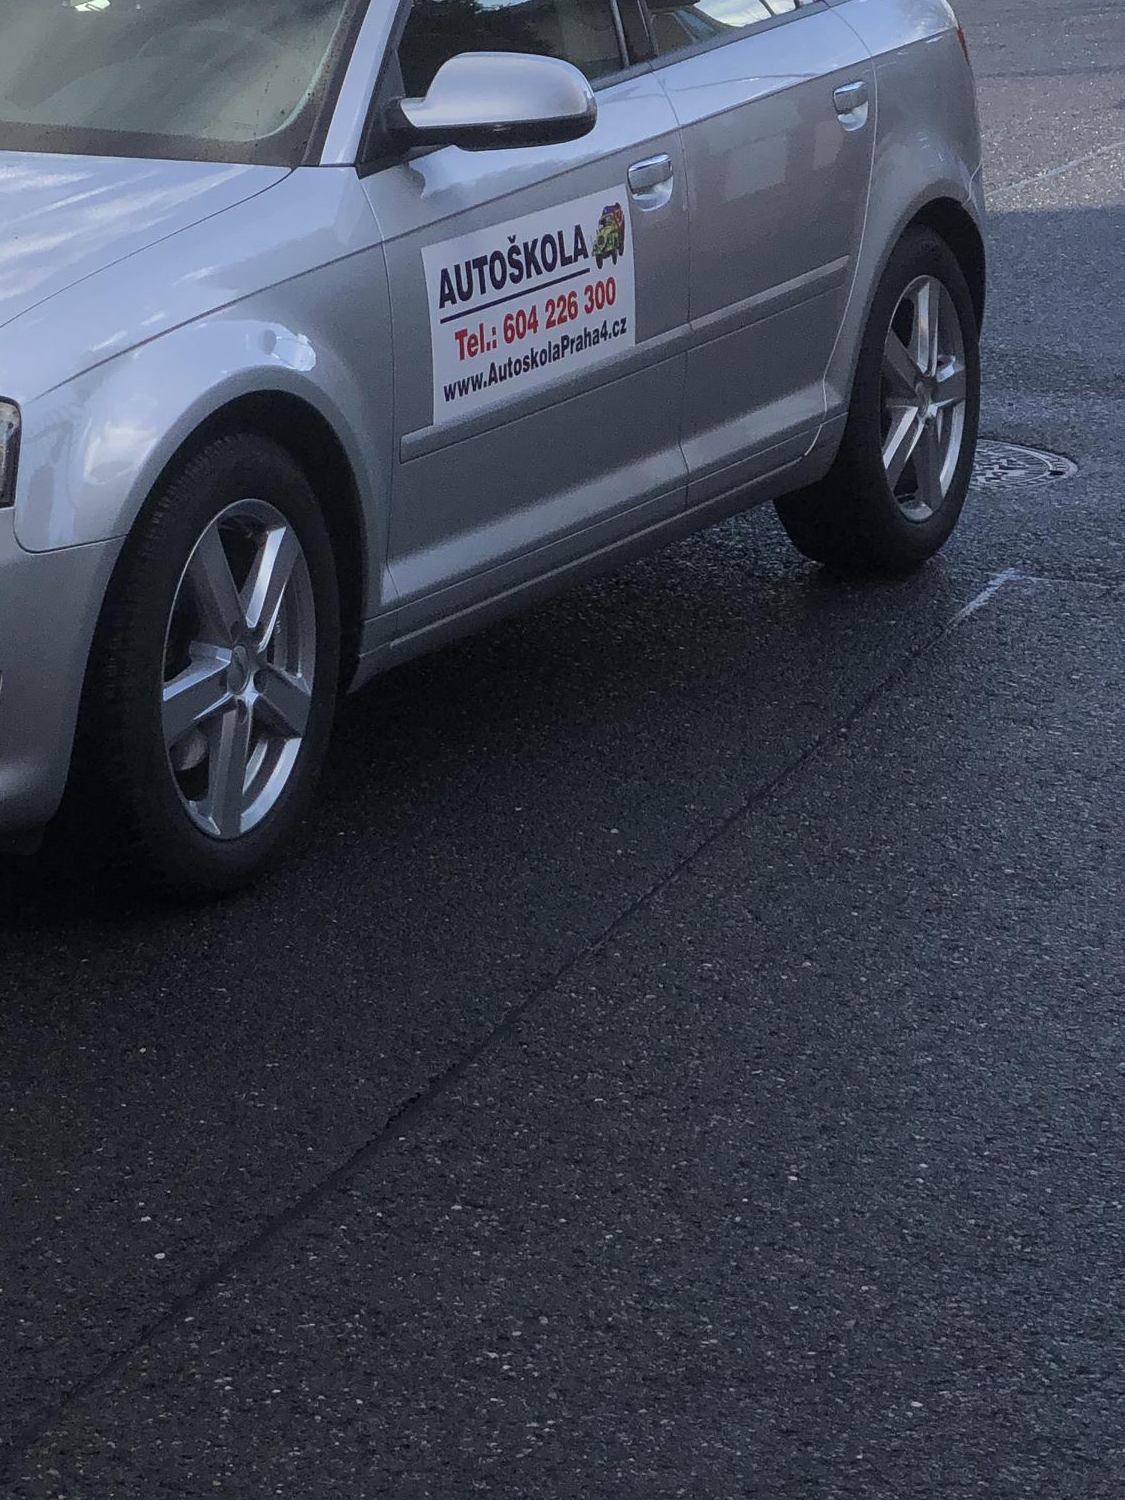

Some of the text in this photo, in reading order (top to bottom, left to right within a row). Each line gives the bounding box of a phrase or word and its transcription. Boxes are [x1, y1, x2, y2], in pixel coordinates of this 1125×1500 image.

[439, 224, 589, 309] AUTOŠKOLA
[443, 317, 627, 402] www.AutoskolaPraha4.cz
[454, 276, 617, 361] Tel.: 604 226 300
